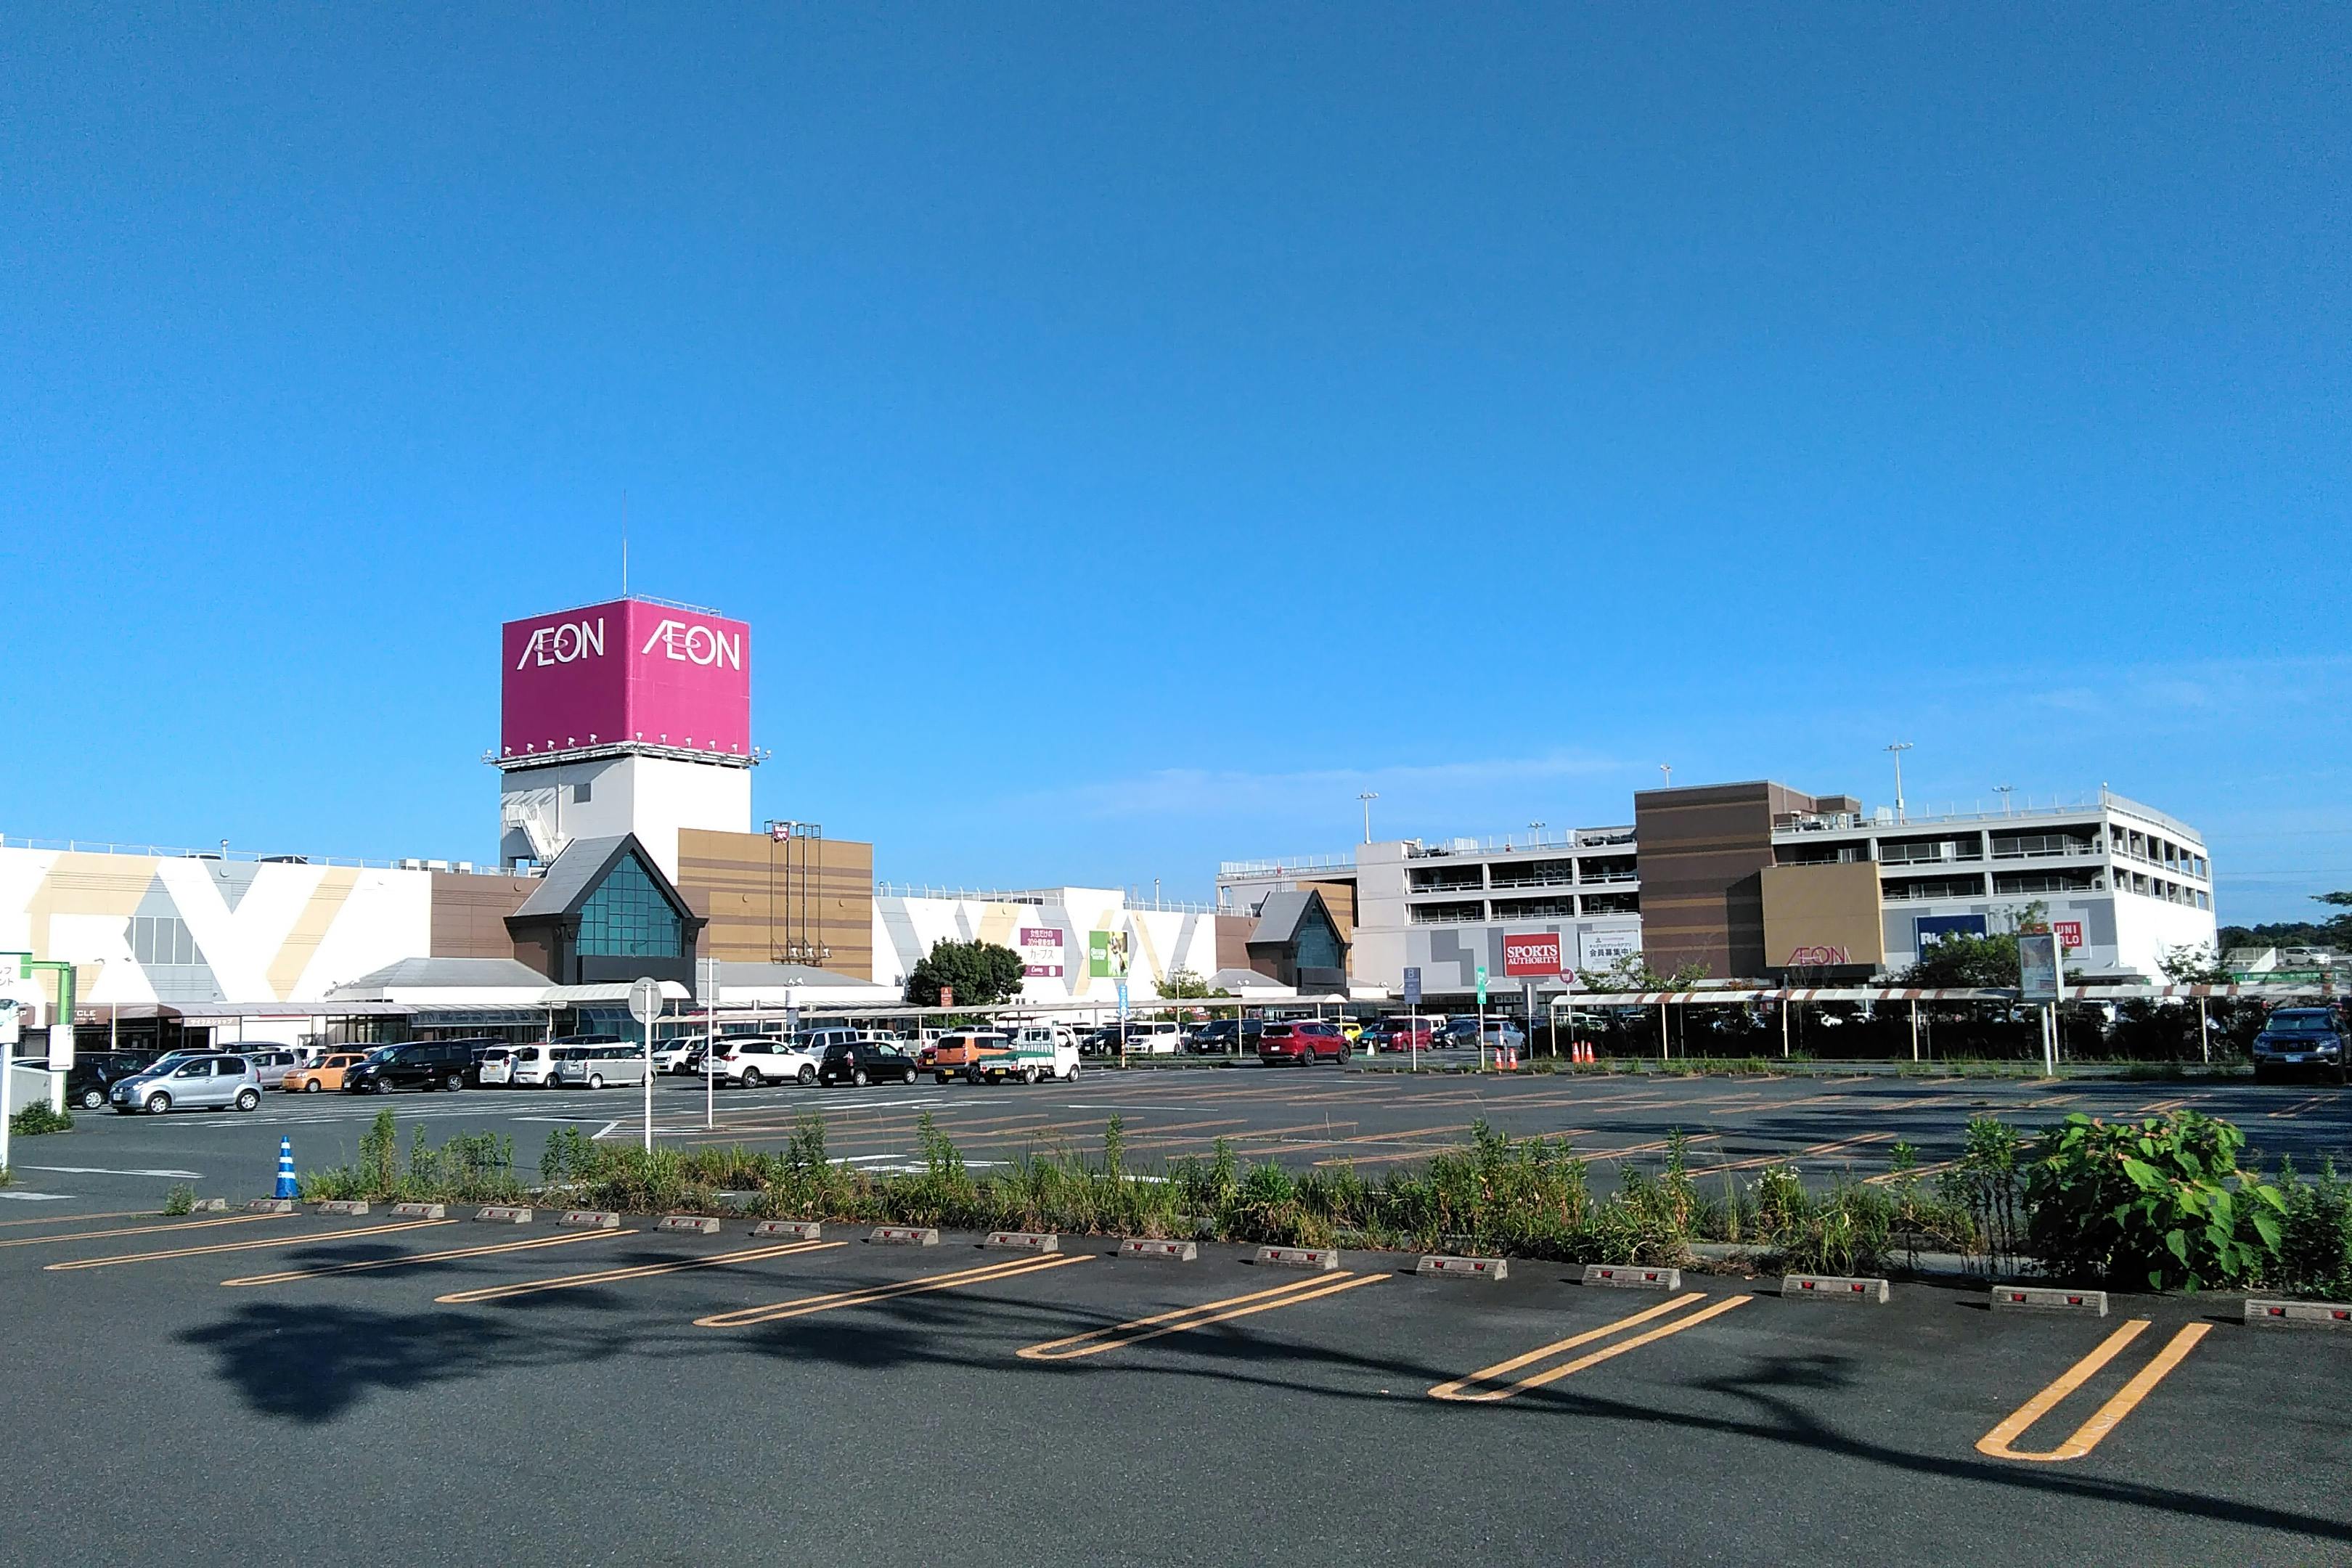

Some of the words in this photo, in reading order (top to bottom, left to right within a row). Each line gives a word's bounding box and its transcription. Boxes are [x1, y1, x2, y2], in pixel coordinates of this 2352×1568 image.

[2057, 925, 2077, 934] UNI
[1507, 944, 1558, 957] SPORTS
[1408, 969, 1415, 978] B
